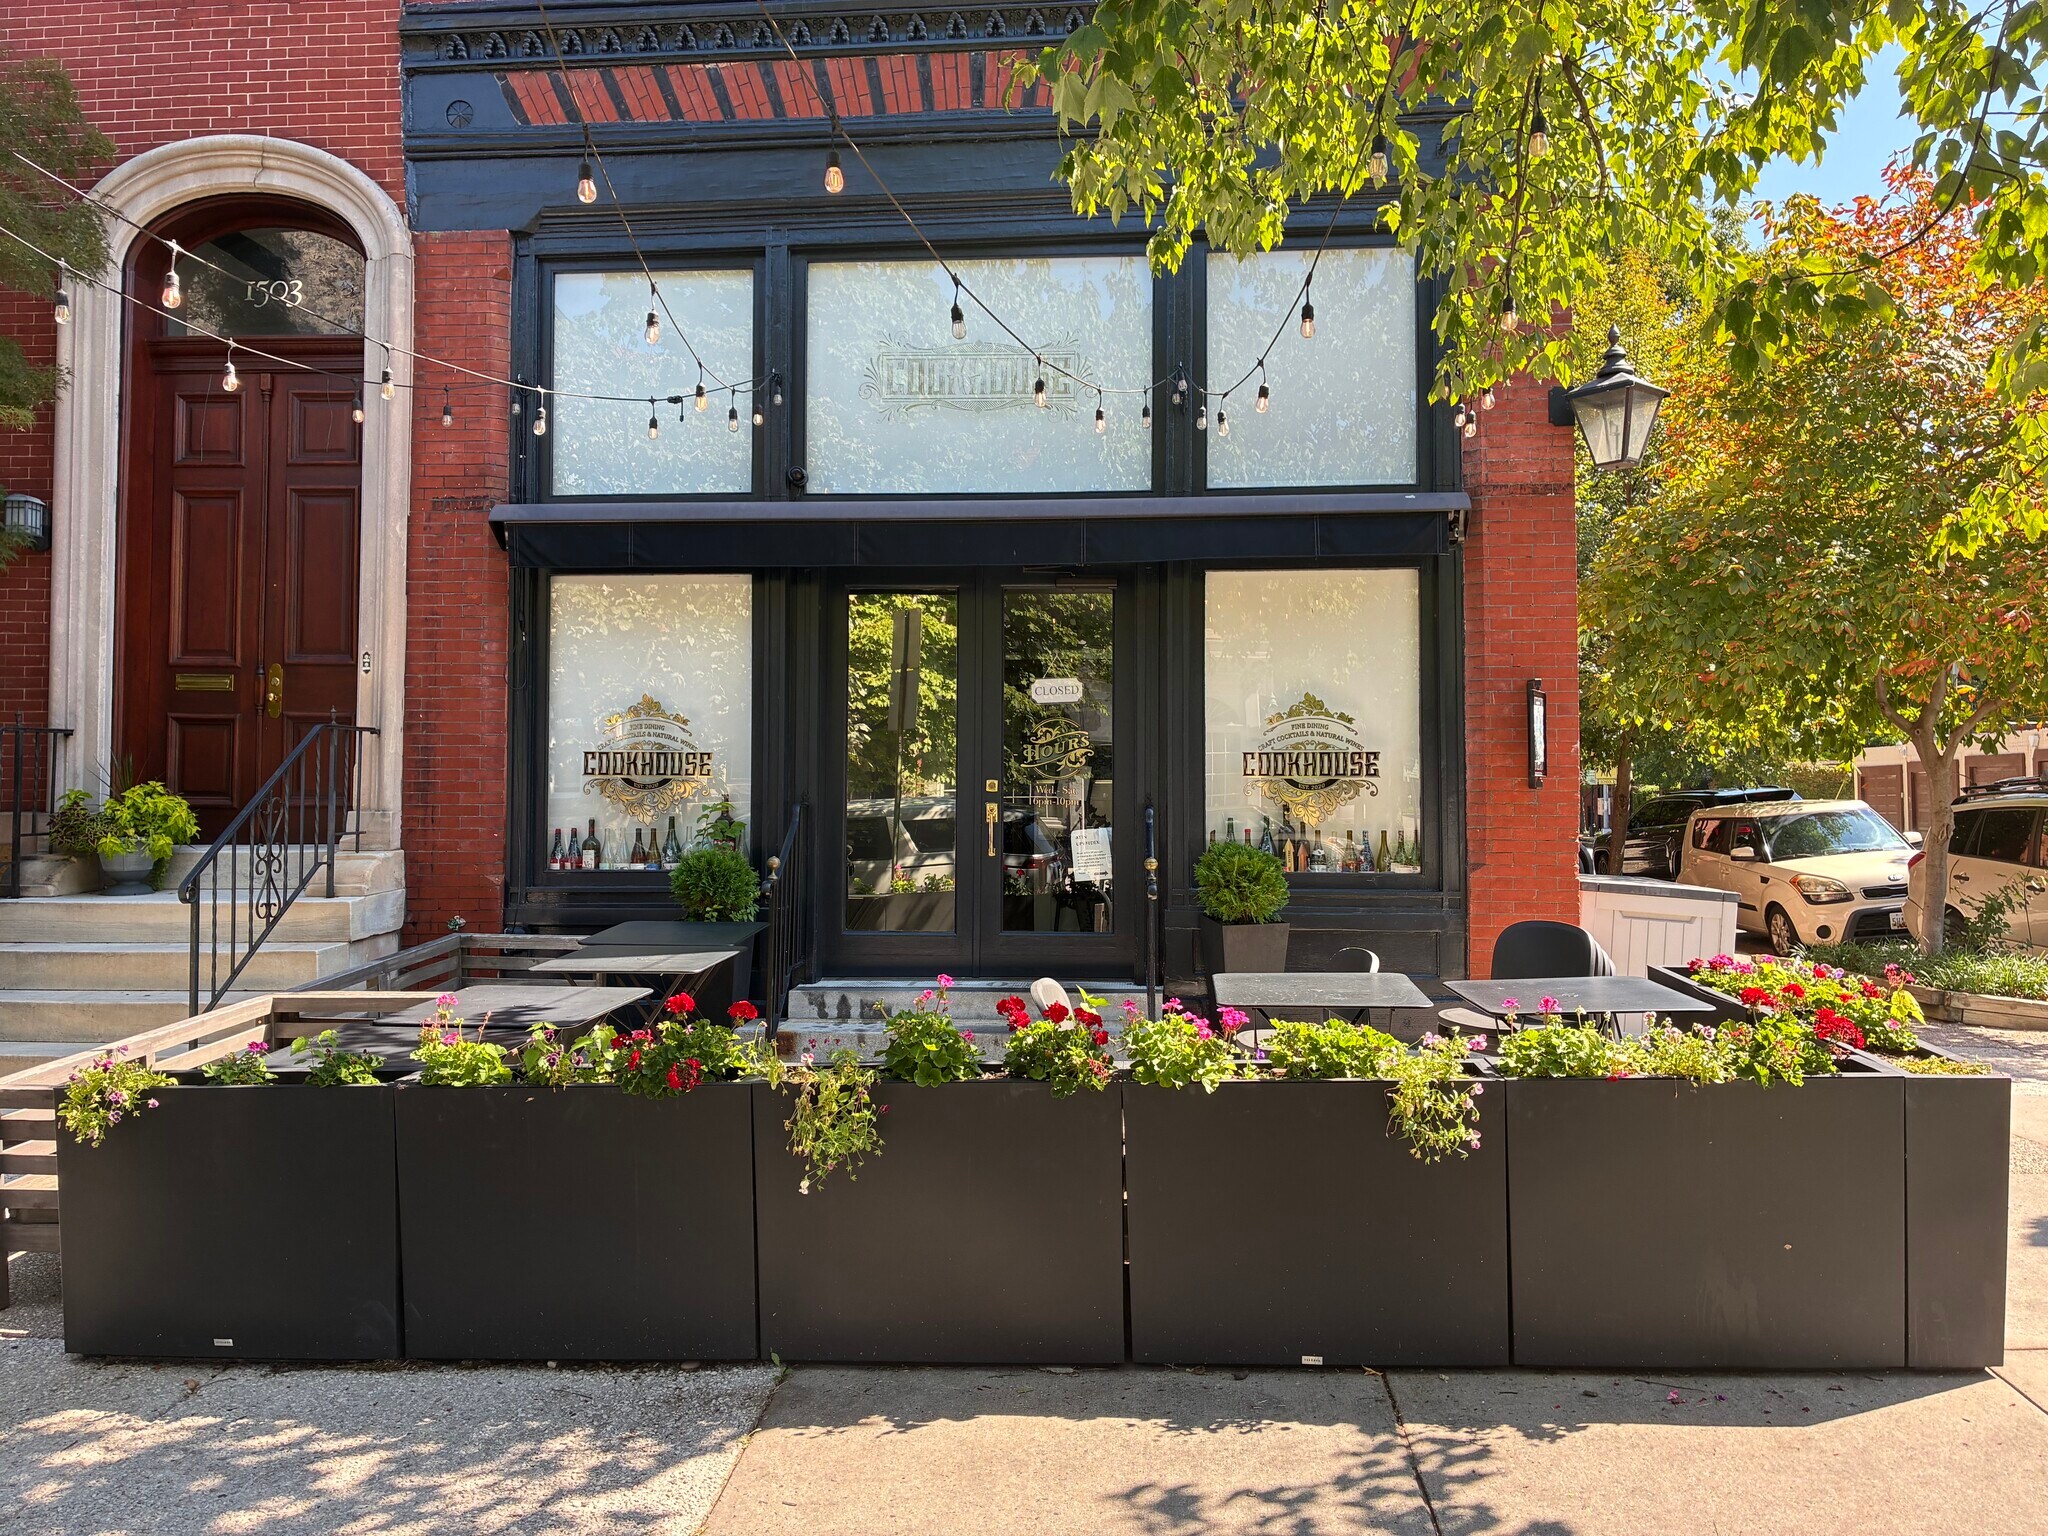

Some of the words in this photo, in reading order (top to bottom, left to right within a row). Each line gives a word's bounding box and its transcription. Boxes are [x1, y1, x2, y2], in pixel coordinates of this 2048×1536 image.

[244, 280, 303, 308] 1503
[1034, 685, 1080, 696] CLOSED
[644, 723, 665, 731] DINING
[653, 732, 679, 743] NATURAL
[680, 738, 699, 752] WINES
[1023, 735, 1090, 763] HOURS
[1258, 737, 1276, 751] CRAFT
[1277, 730, 1309, 742] COCKTAILS
[1316, 731, 1344, 742] NATURAL
[1345, 737, 1365, 751] WINES
[582, 751, 714, 777] COOKHOUSE
[1242, 751, 1381, 777] COOKHOUSE
